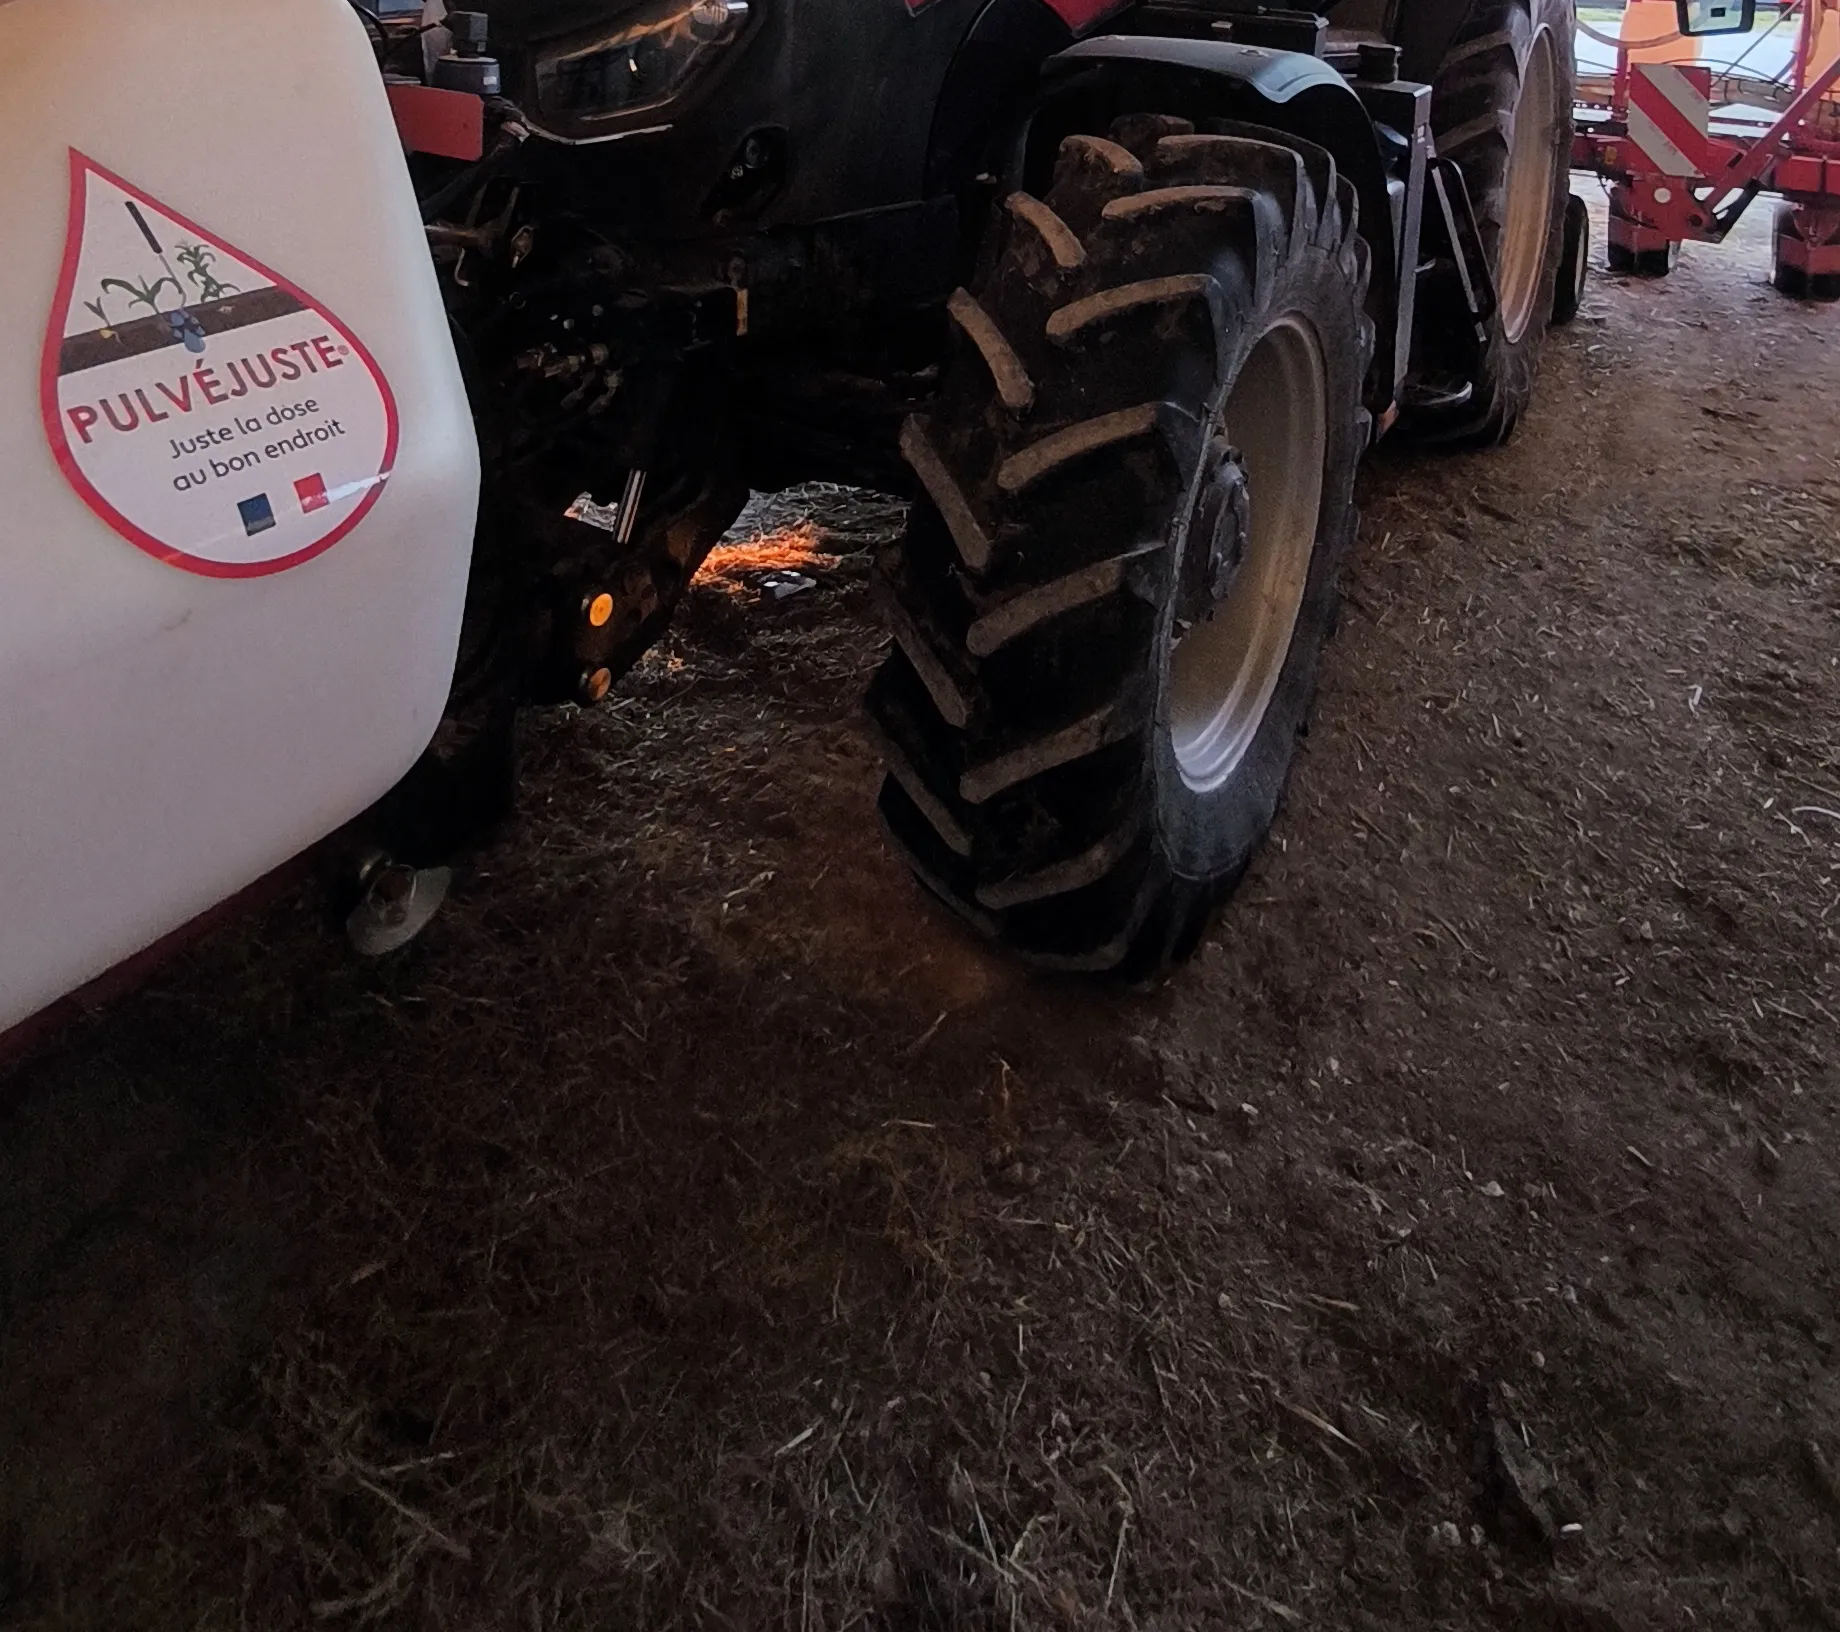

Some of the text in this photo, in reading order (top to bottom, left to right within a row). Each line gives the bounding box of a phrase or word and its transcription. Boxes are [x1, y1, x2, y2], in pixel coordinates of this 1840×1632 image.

[66, 335, 343, 444] PULVÉJUSTE
[169, 399, 320, 459] Juste la dose
[173, 420, 346, 491] au bon endroit
